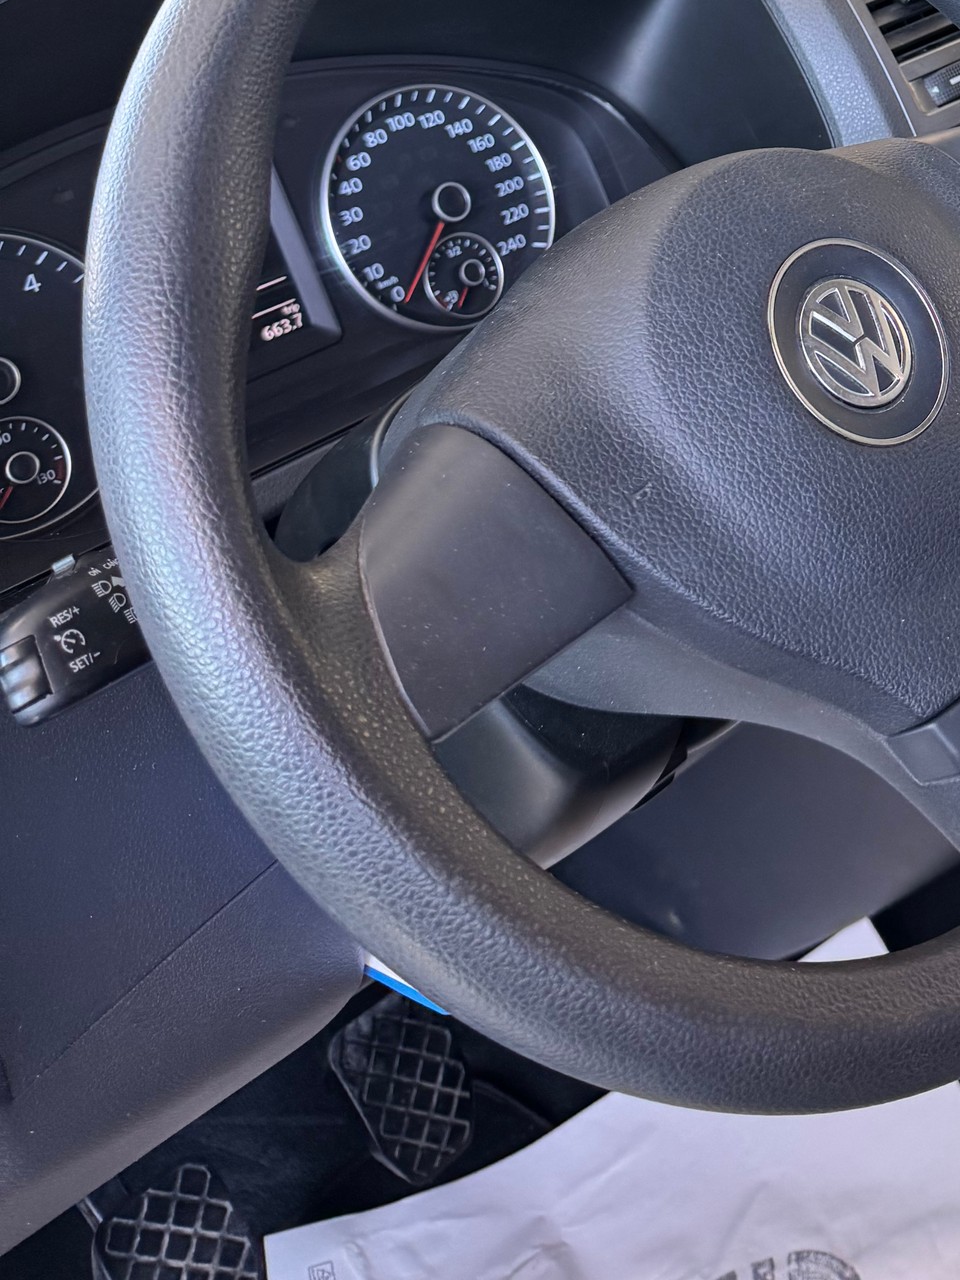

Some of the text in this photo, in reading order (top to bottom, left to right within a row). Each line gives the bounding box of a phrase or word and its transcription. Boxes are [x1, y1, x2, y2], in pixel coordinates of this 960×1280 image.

[385, 111, 416, 132] 100
[417, 109, 446, 130] 120
[444, 118, 474, 139] 140
[362, 128, 388, 148] 80
[466, 133, 496, 154] 160
[346, 151, 372, 171] 60
[485, 152, 513, 173] 180
[338, 177, 364, 197] 40
[494, 176, 525, 198] 200
[339, 206, 364, 227] 30
[500, 203, 530, 226] 220
[350, 234, 372, 255] 20
[496, 234, 527, 257] 240
[363, 262, 385, 281] 10
[23, 273, 42, 293] 4
[390, 285, 406, 302] 0
[260, 312, 303, 341] 663.7
[49, 605, 80, 628] RES/+
[69, 651, 101, 673] SET/-
